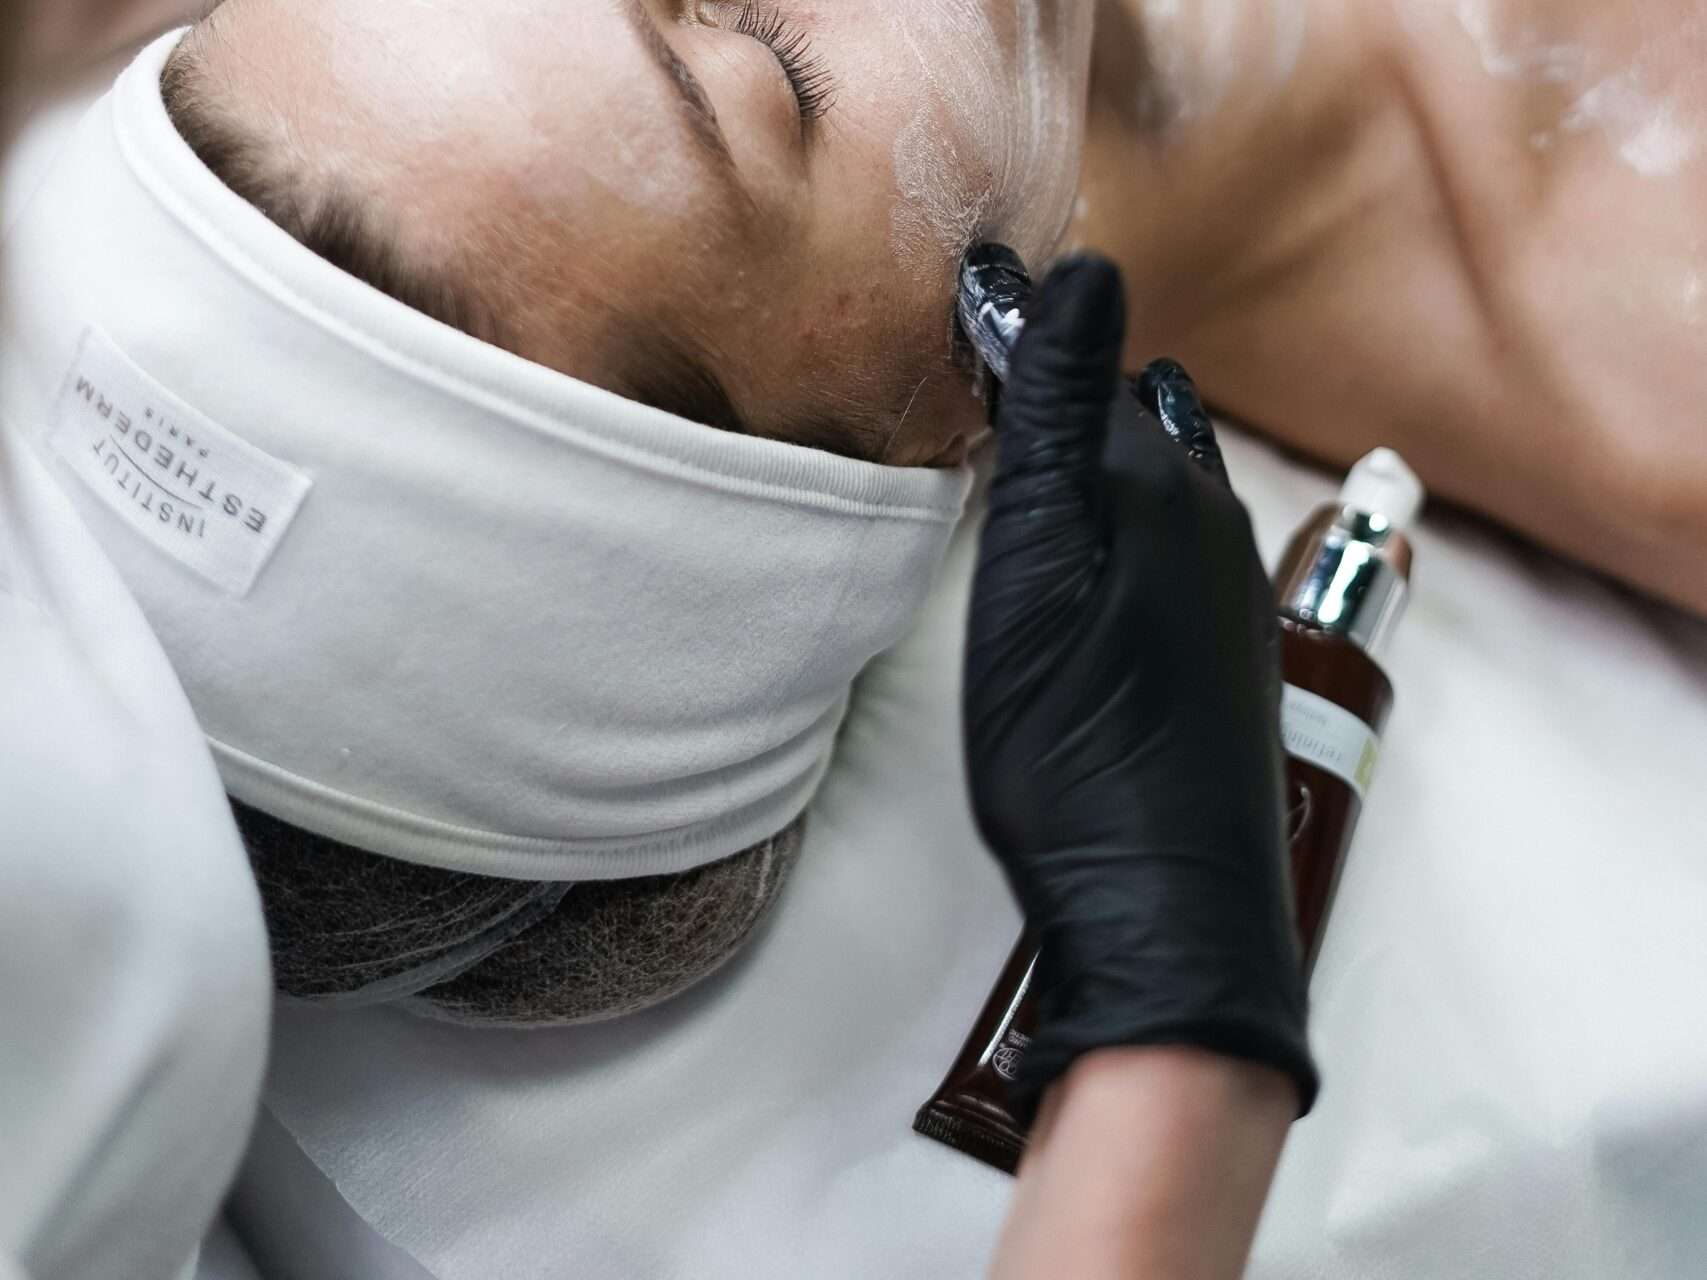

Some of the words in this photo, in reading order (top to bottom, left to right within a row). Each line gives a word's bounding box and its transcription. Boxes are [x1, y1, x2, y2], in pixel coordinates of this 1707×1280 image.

[76, 376, 267, 534] ESTHEDERM
[144, 407, 210, 458] PARIS
[92, 439, 206, 538] INSTITUT
